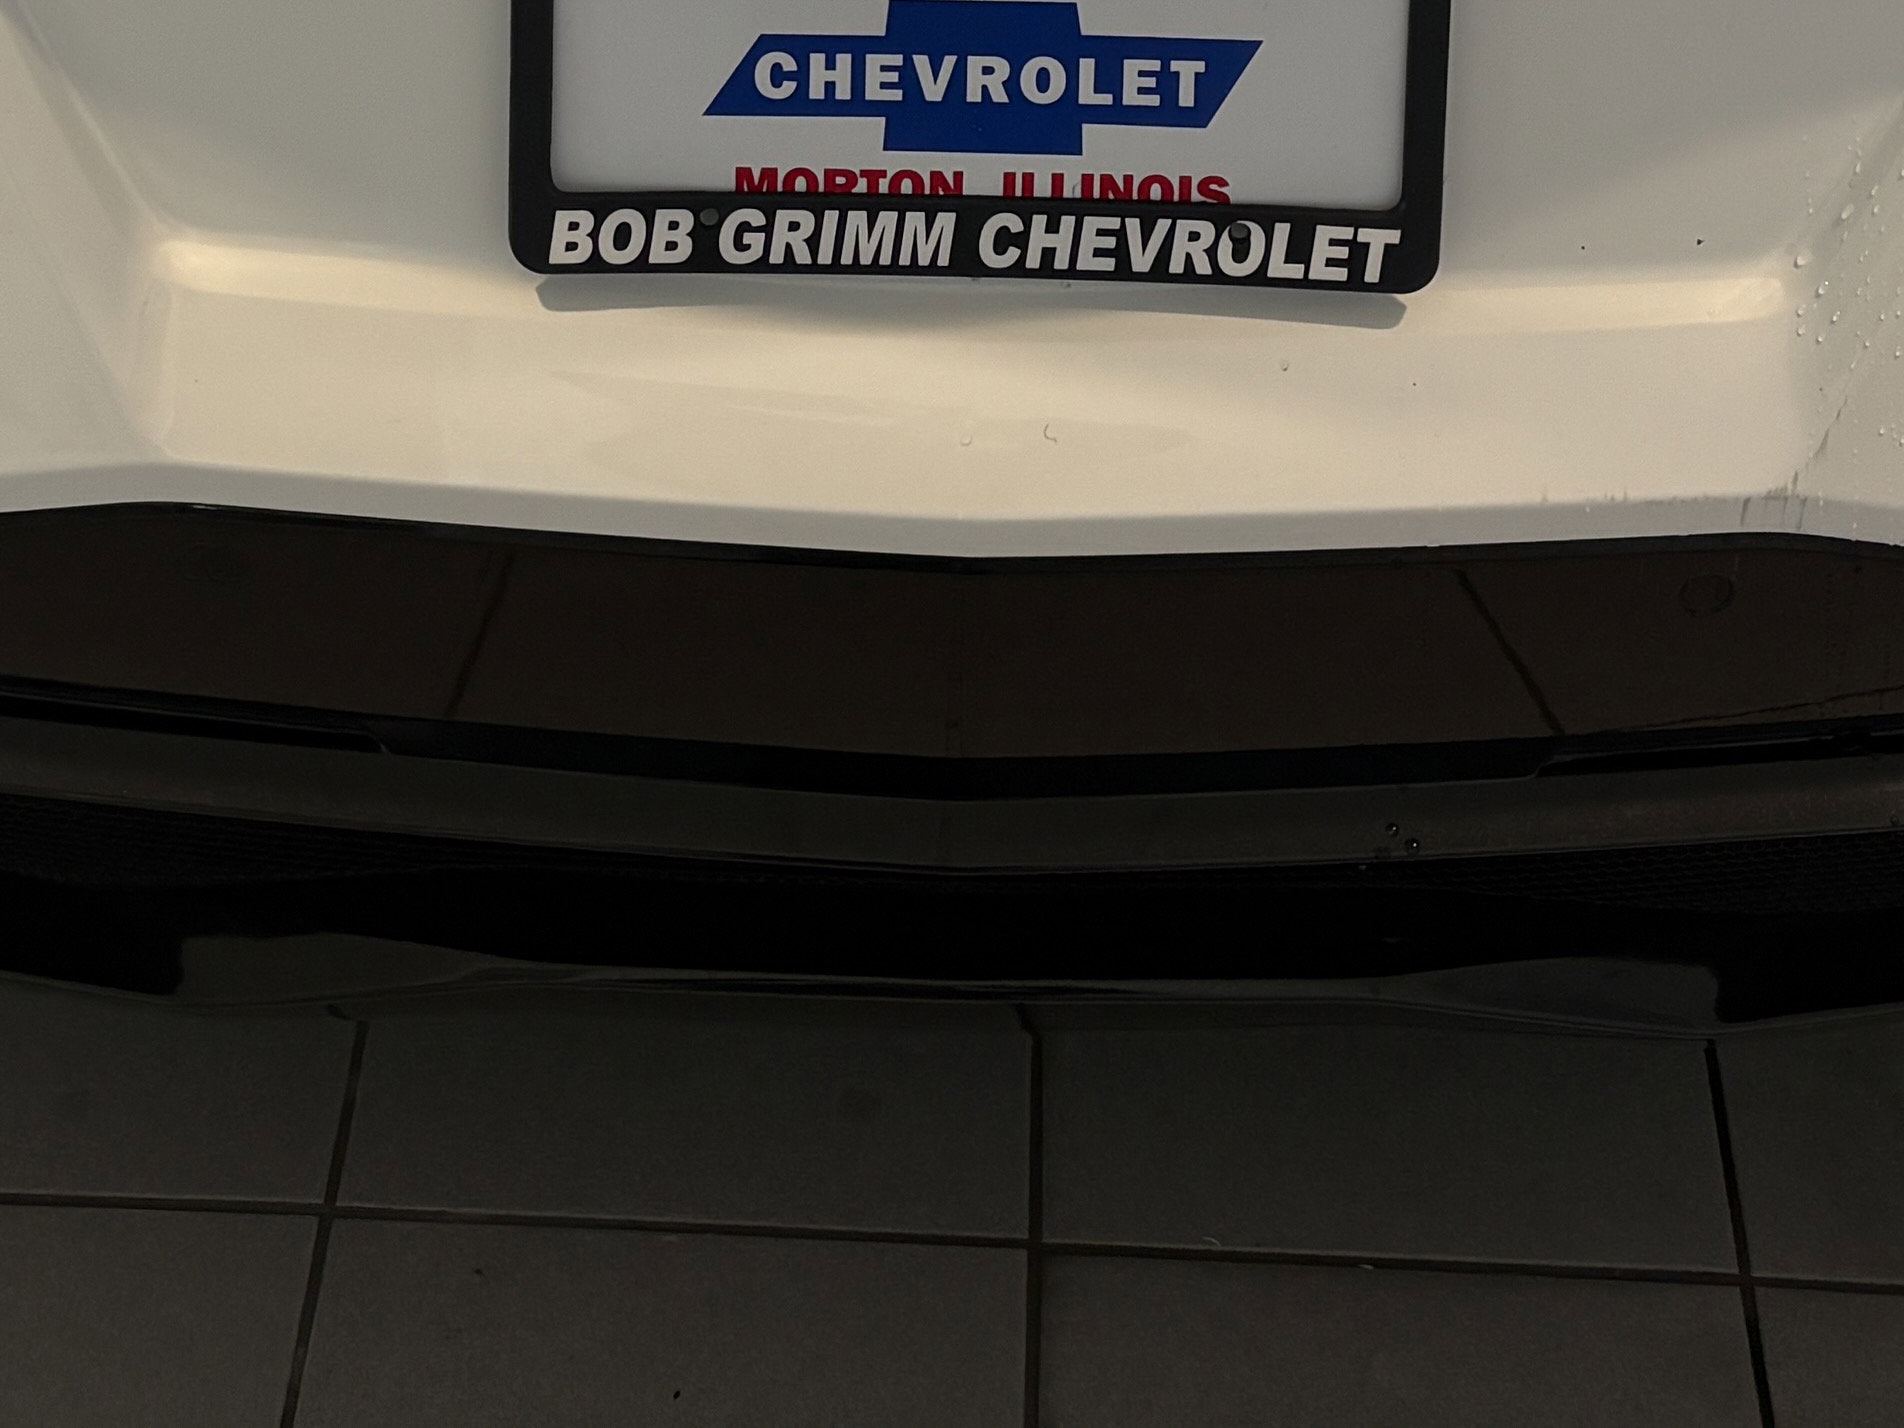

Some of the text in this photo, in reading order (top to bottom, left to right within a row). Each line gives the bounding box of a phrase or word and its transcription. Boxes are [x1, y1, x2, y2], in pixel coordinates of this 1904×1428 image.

[753, 50, 1207, 109] CHEVROLET
[547, 207, 1403, 284] BOB GRIMM CHEVROLET
